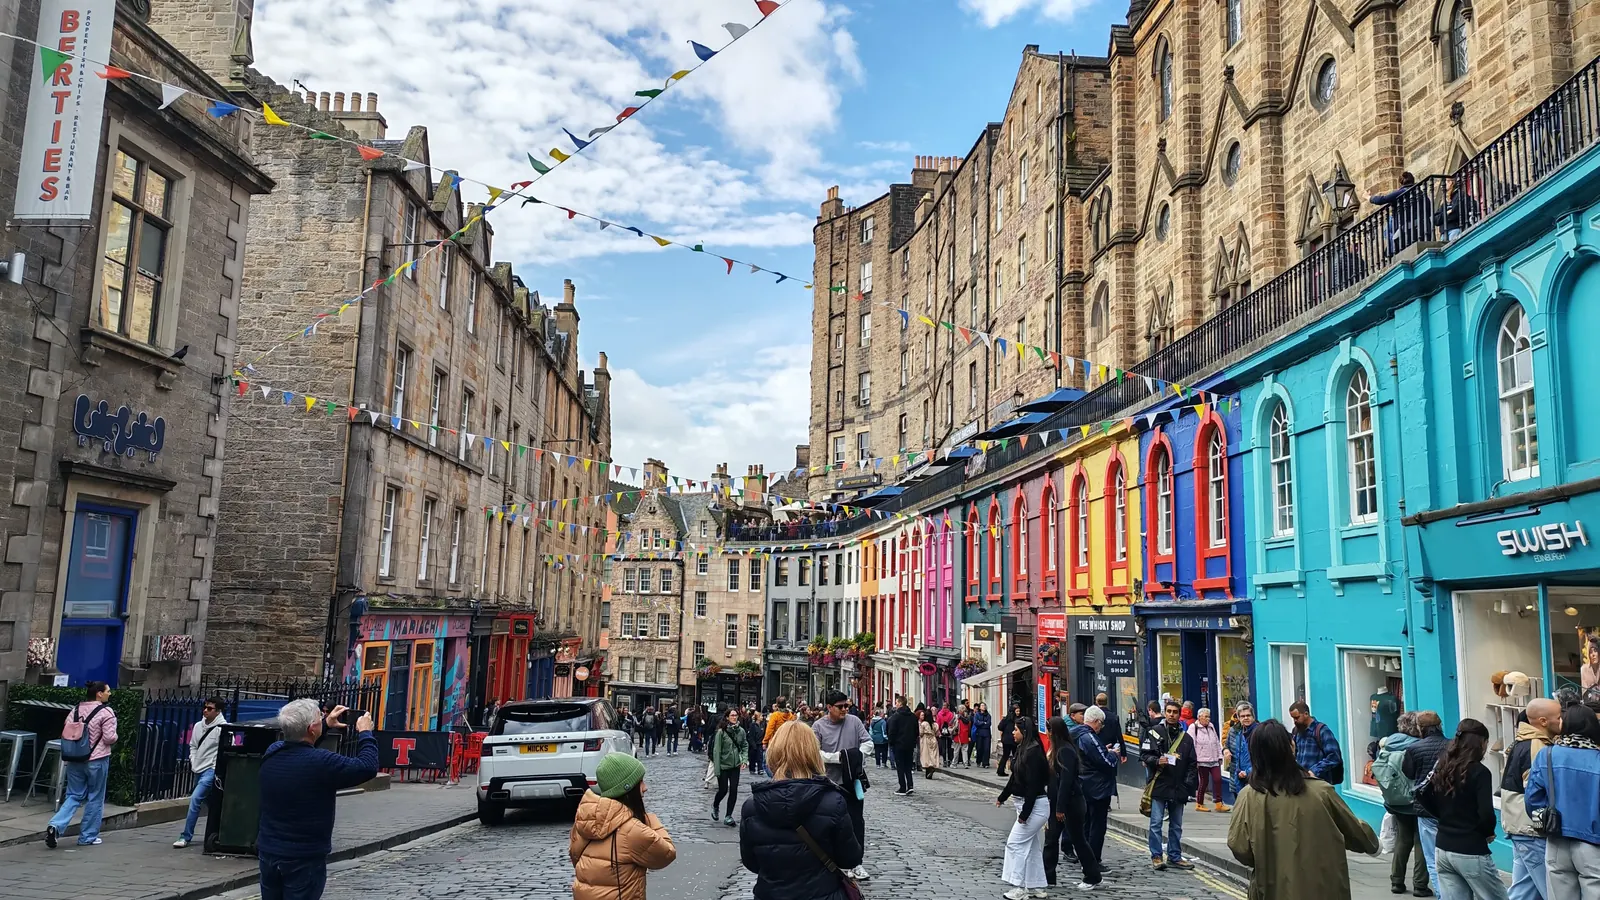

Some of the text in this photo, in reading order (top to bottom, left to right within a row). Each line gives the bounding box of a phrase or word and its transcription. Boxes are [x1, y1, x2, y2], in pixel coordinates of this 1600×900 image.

[83, 10, 92, 44] PROPER
[38, 10, 80, 202] BERTIES
[76, 77, 84, 106] CHIPS
[67, 115, 79, 174] RESTAURANT
[1496, 519, 1590, 556] SWISH
[1533, 552, 1567, 563] EDINBURGH
[392, 619, 439, 635] MARIACHI
[1078, 617, 1126, 632] THE WHISKY SHOP
[392, 737, 417, 766] T
